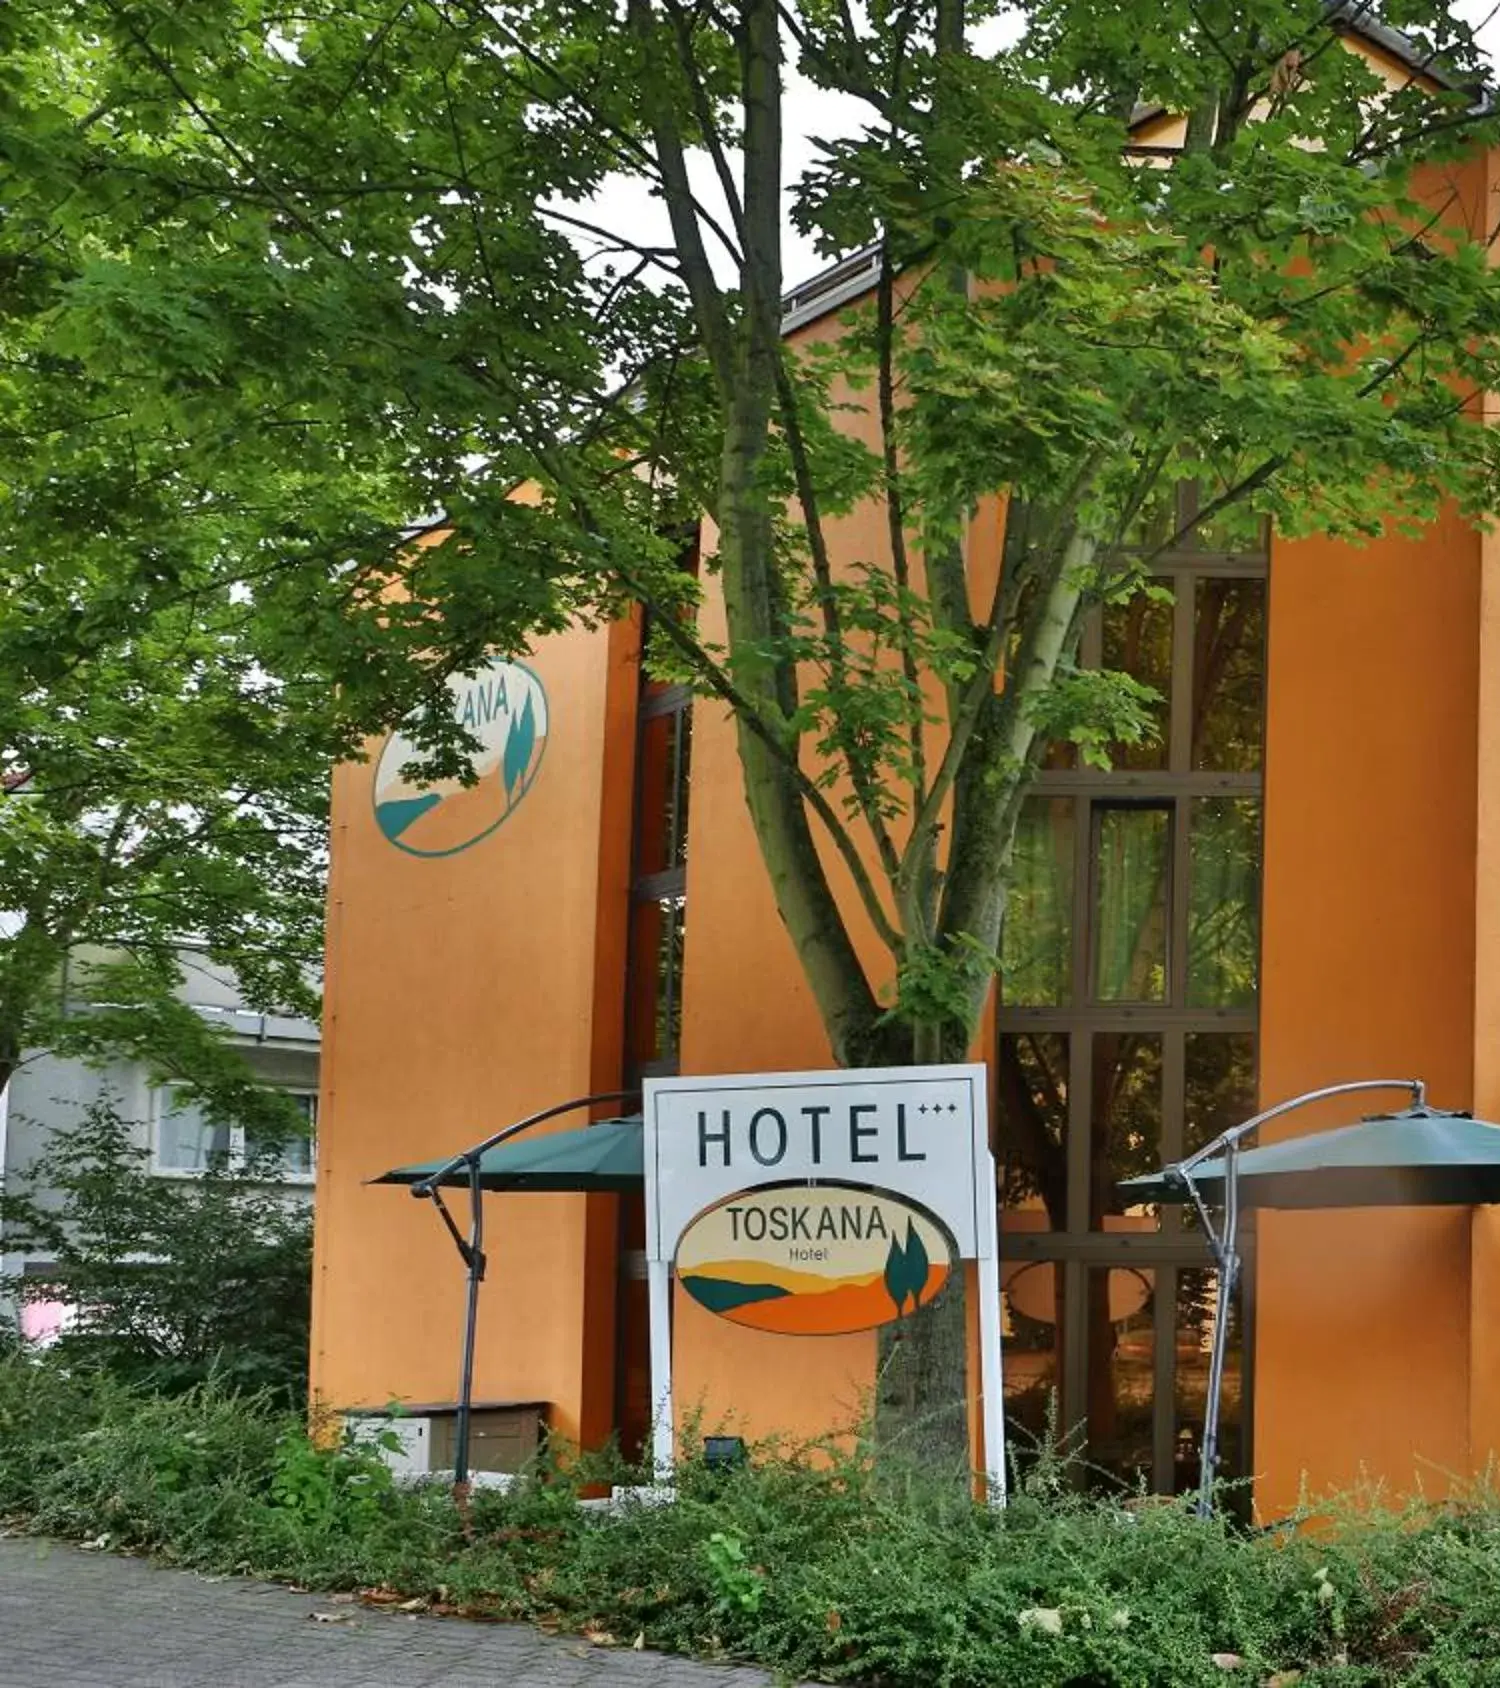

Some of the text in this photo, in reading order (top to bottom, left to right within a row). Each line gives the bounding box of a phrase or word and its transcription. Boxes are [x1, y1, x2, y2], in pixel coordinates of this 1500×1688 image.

[698, 1104, 926, 1166] HOTEL
[726, 1205, 888, 1241] TOSKANA
[789, 1248, 828, 1261] Hotel
